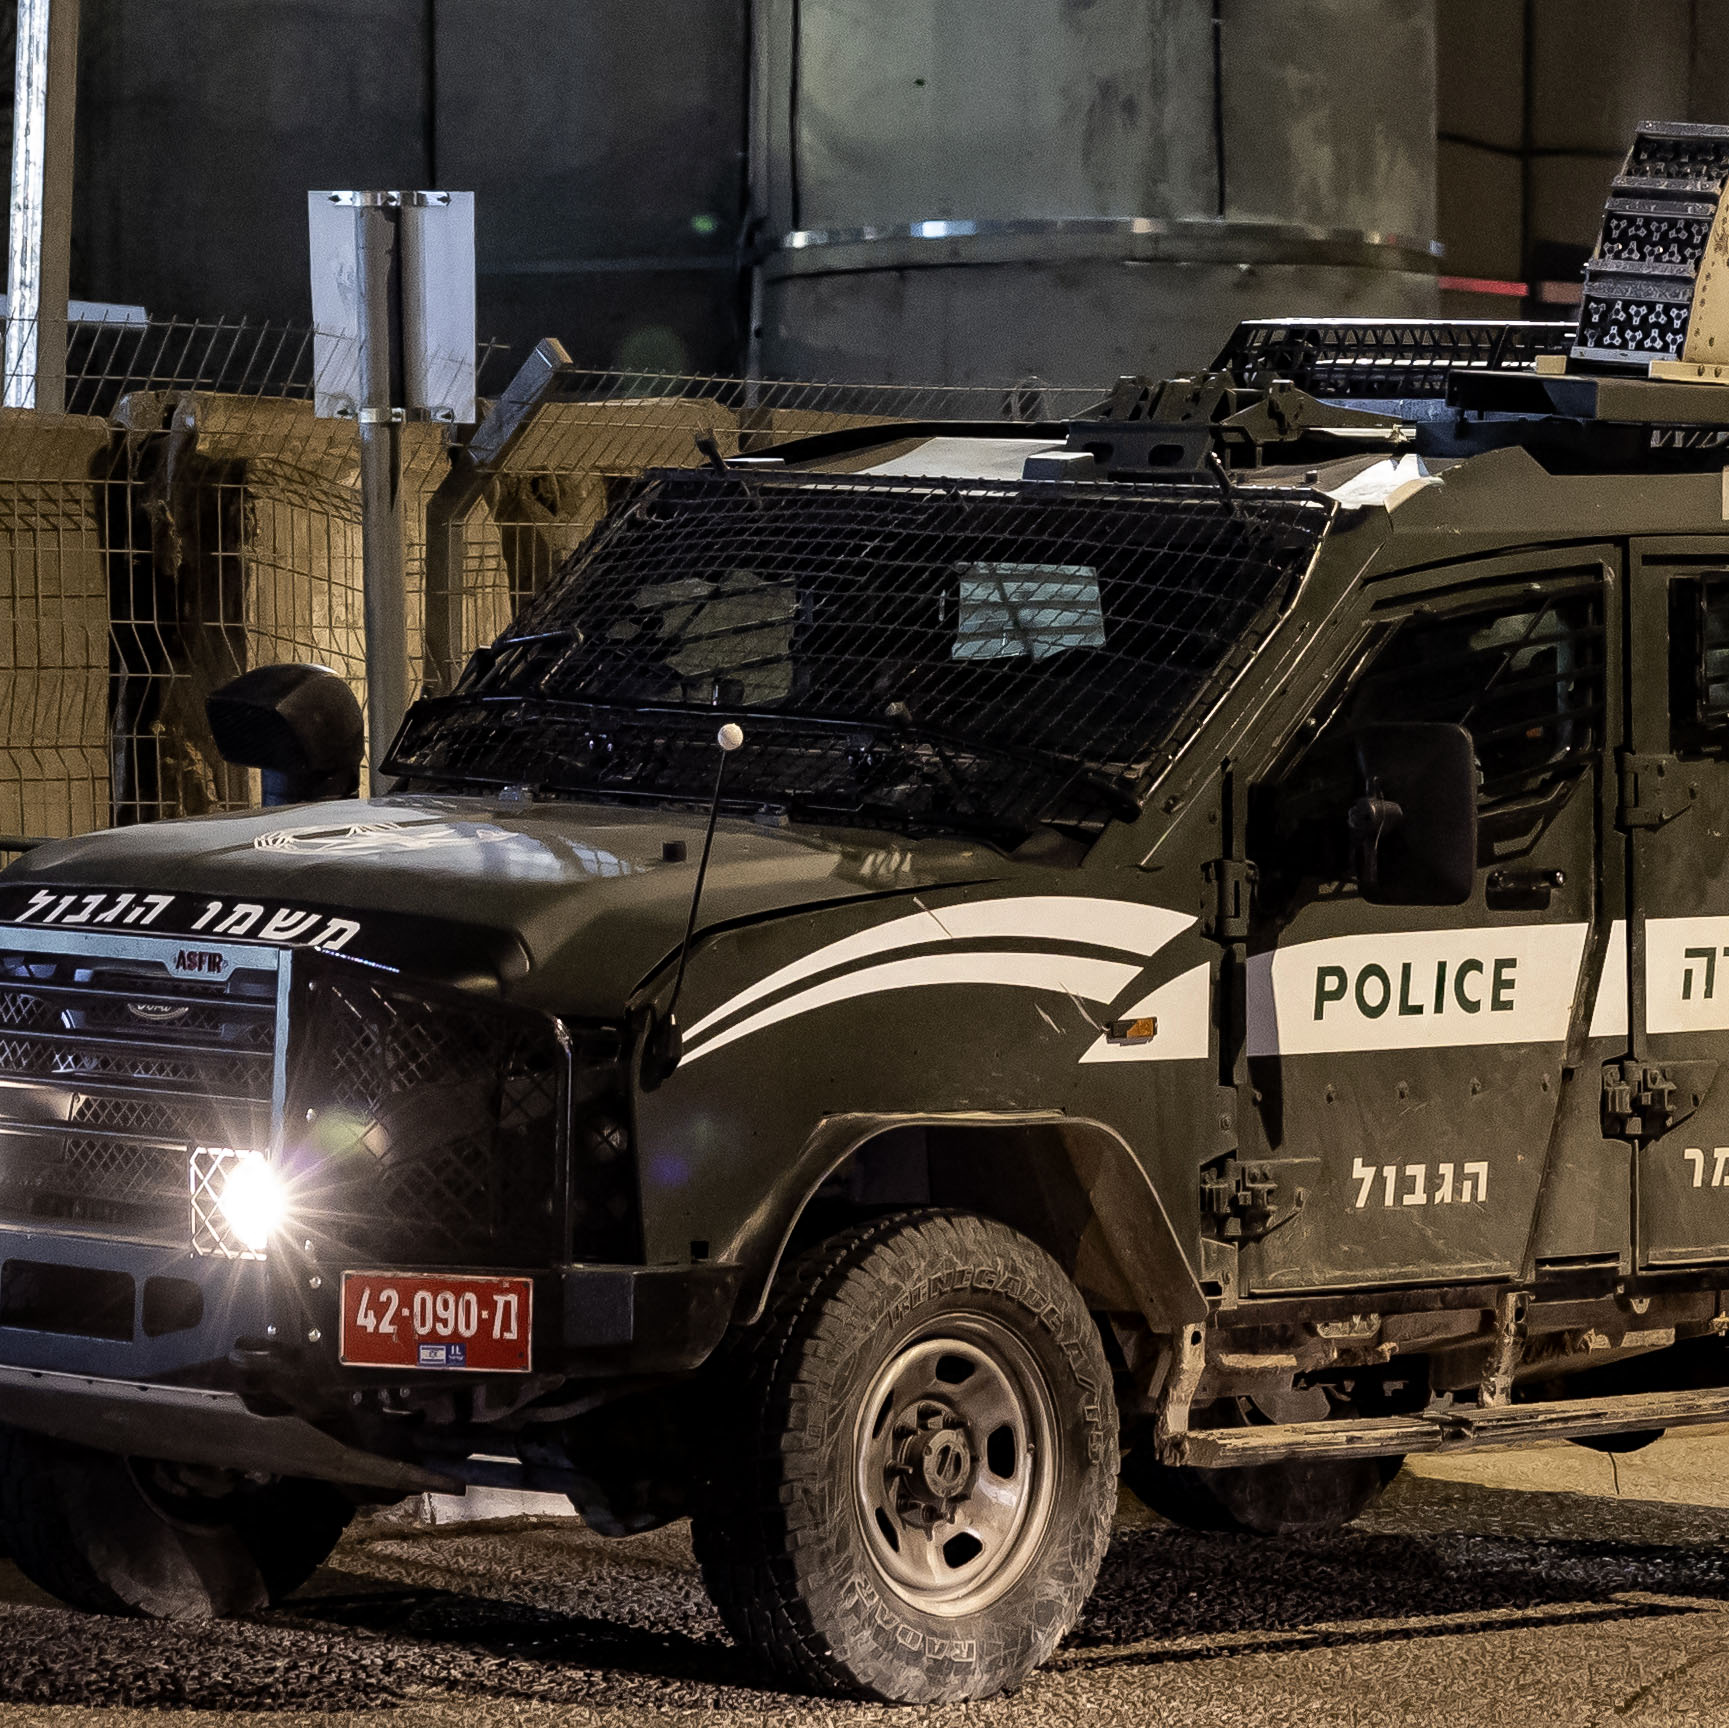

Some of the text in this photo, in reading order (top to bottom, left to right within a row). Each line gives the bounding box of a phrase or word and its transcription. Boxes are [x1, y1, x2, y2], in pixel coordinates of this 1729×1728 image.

[12, 888, 176, 926] הגבול
[175, 949, 224, 974] ASFIR
[1314, 958, 1517, 1020] POLICE
[1353, 1158, 1488, 1208] הגבול
